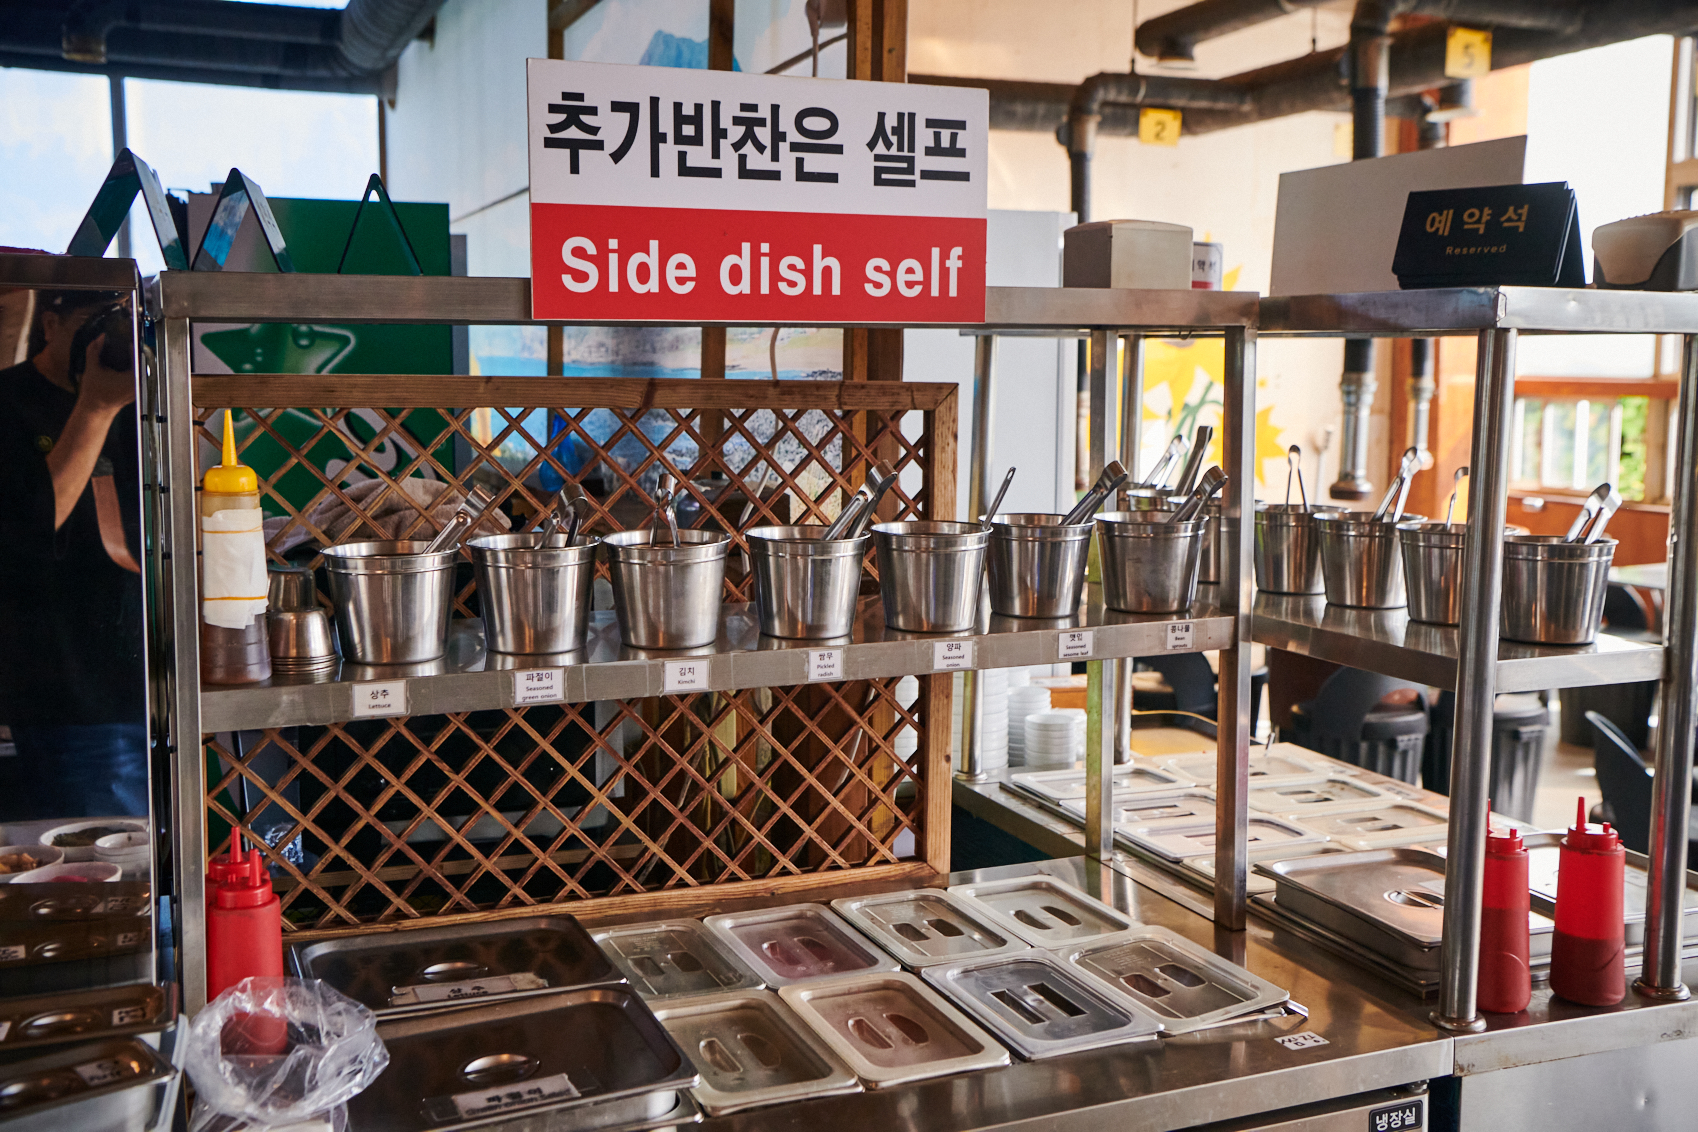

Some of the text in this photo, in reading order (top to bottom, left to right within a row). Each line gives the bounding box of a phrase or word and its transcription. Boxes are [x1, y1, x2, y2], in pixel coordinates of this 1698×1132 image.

[1153, 120, 1167, 141] 2
[543, 91, 971, 189] 추가반찬은 셀프
[1445, 244, 1507, 256] Reserved
[560, 235, 964, 299] Side dish self
[946, 643, 962, 652] 양파
[525, 672, 553, 682] 파절이
[678, 666, 696, 677] 김치
[525, 684, 554, 692] Seasoned
[369, 689, 390, 700] 상추
[522, 692, 558, 702] green onion
[368, 702, 391, 710] Lettuce
[1375, 1106, 1416, 1132] 냉장실
